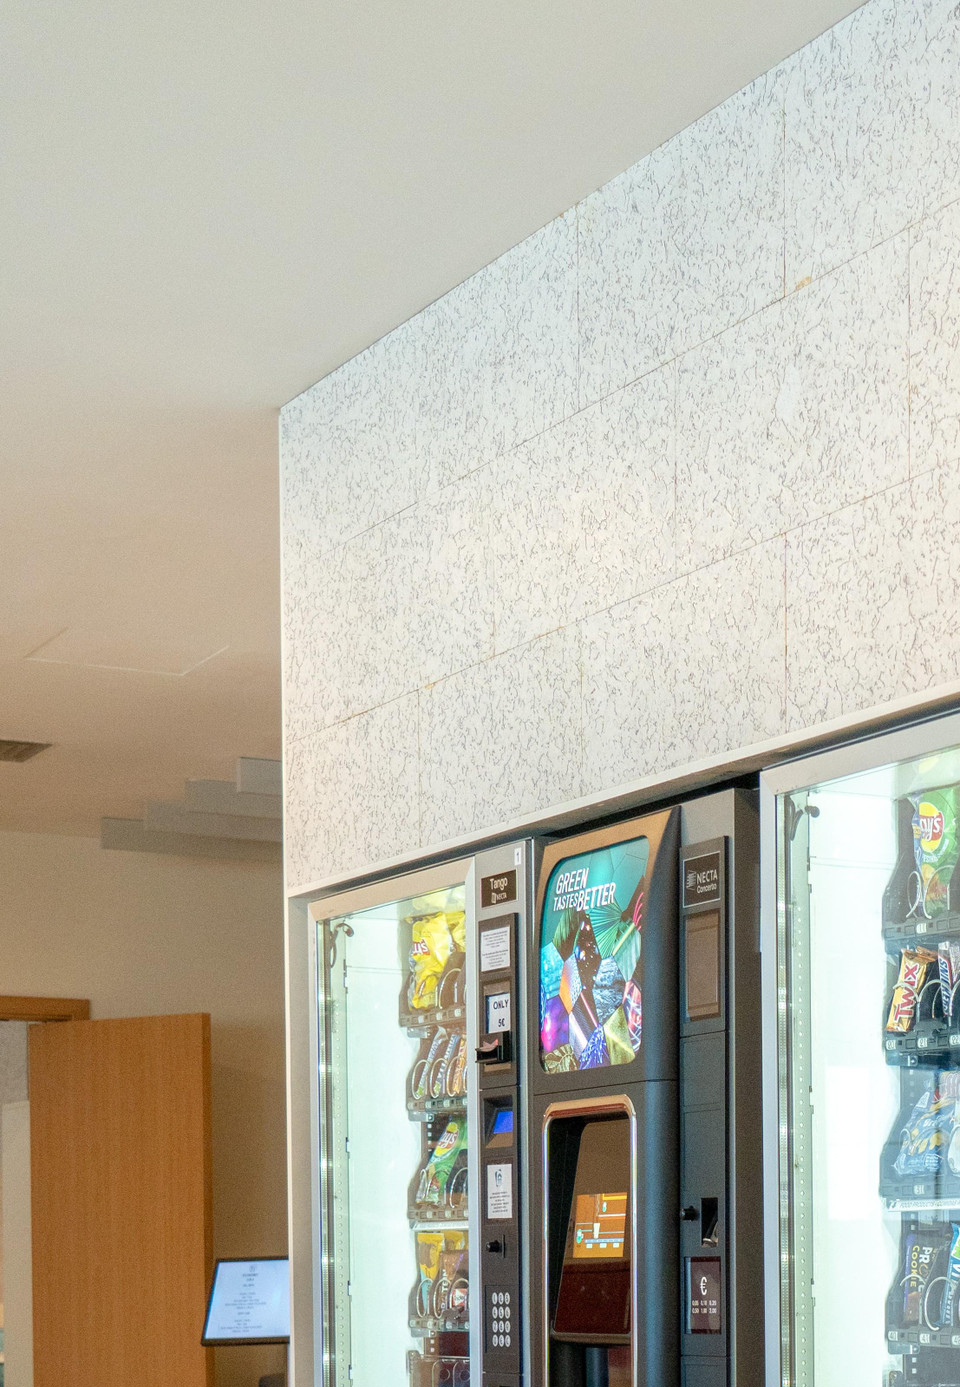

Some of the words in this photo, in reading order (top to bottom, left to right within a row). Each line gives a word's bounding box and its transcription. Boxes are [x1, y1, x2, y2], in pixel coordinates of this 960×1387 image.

[919, 814, 942, 842] ay's
[489, 876, 509, 891] Tango
[556, 867, 589, 894] GREEN
[696, 869, 718, 885] NECTA
[553, 892, 579, 912] TASTES
[576, 881, 617, 912] BETTER
[893, 961, 919, 1022] TWIX
[493, 999, 509, 1010] ONLY
[700, 1276, 708, 1296] €
